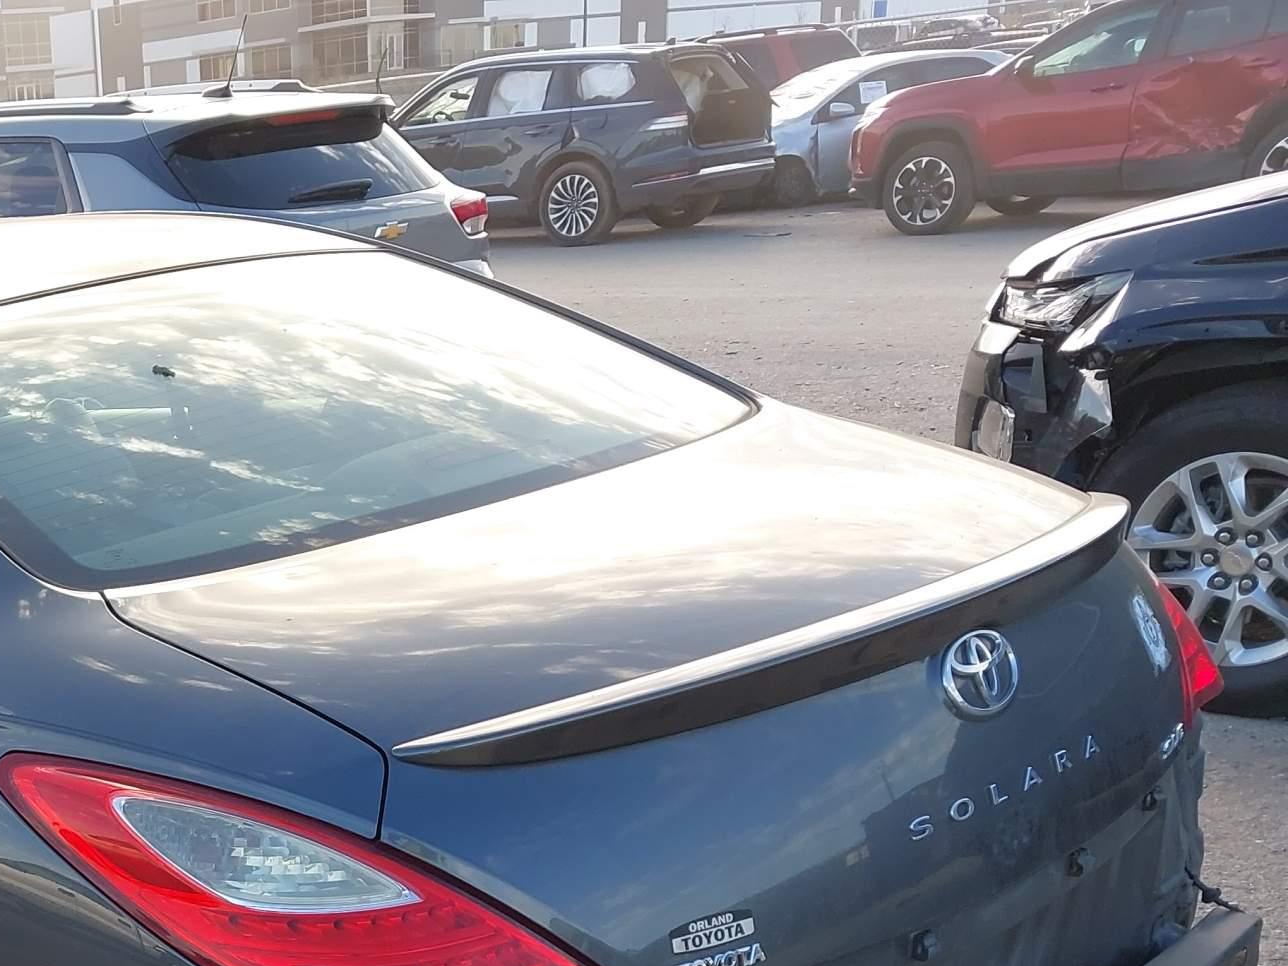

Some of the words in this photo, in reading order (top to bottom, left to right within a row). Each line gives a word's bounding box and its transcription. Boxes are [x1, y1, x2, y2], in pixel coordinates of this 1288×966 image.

[909, 735, 1100, 840] SOLARA
[688, 912, 734, 933] ORLAND
[681, 923, 746, 951] TOYOTA
